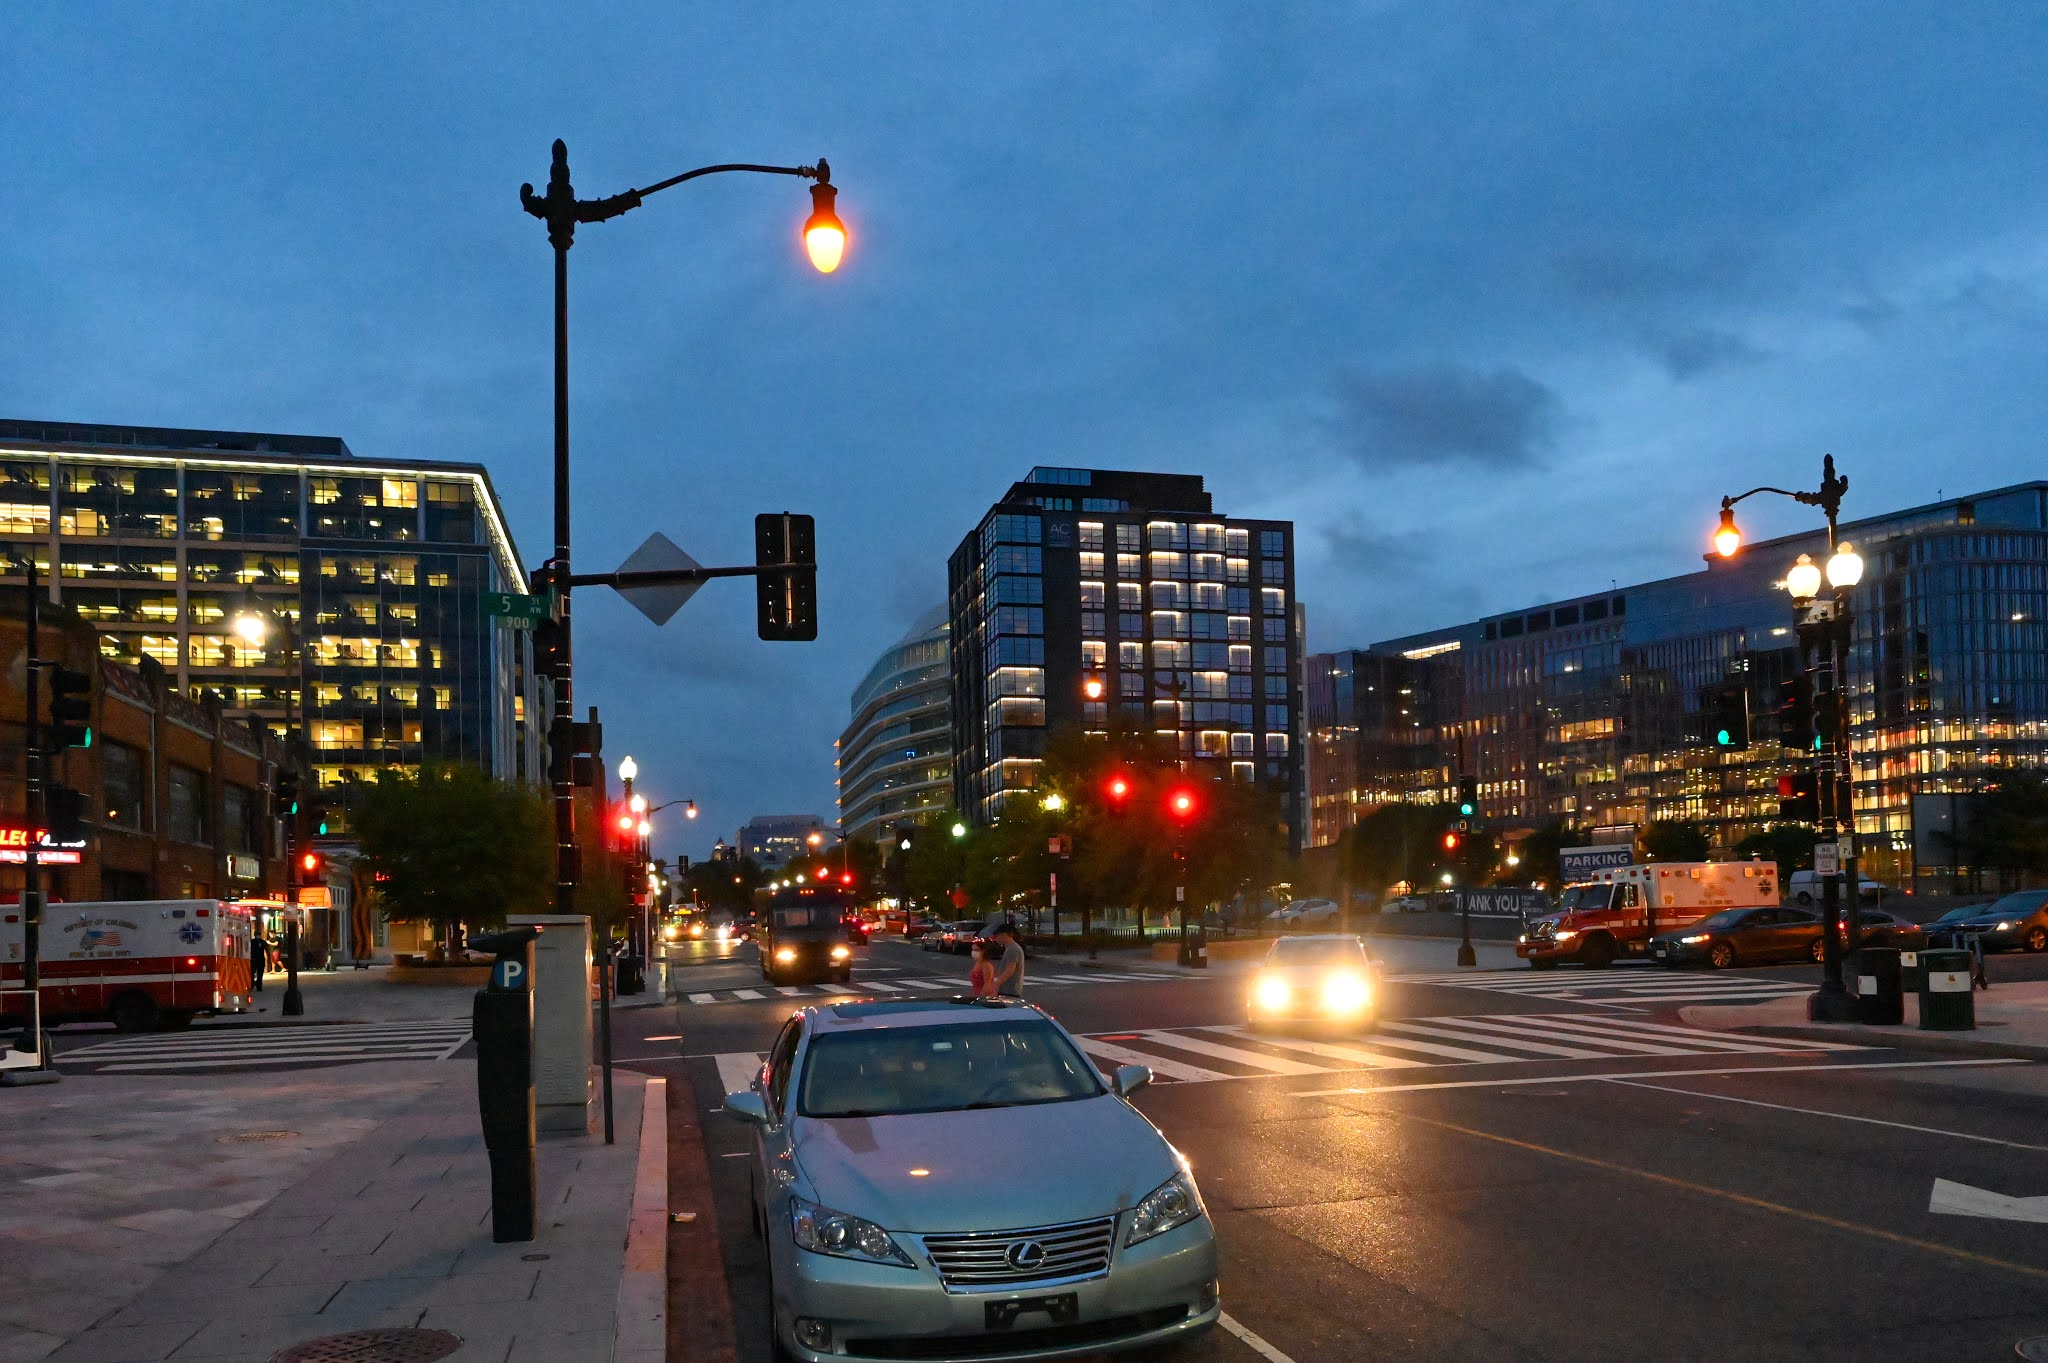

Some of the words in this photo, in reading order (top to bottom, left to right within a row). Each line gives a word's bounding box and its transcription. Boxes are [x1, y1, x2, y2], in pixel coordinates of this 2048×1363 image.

[1050, 523, 1070, 535] AC
[502, 595, 511, 613] 5
[531, 597, 540, 605] ST
[530, 606, 541, 614] NW
[506, 616, 529, 629] 900
[1564, 853, 1629, 867] PARKING
[1495, 894, 1519, 912] YOU
[503, 960, 522, 987] P
